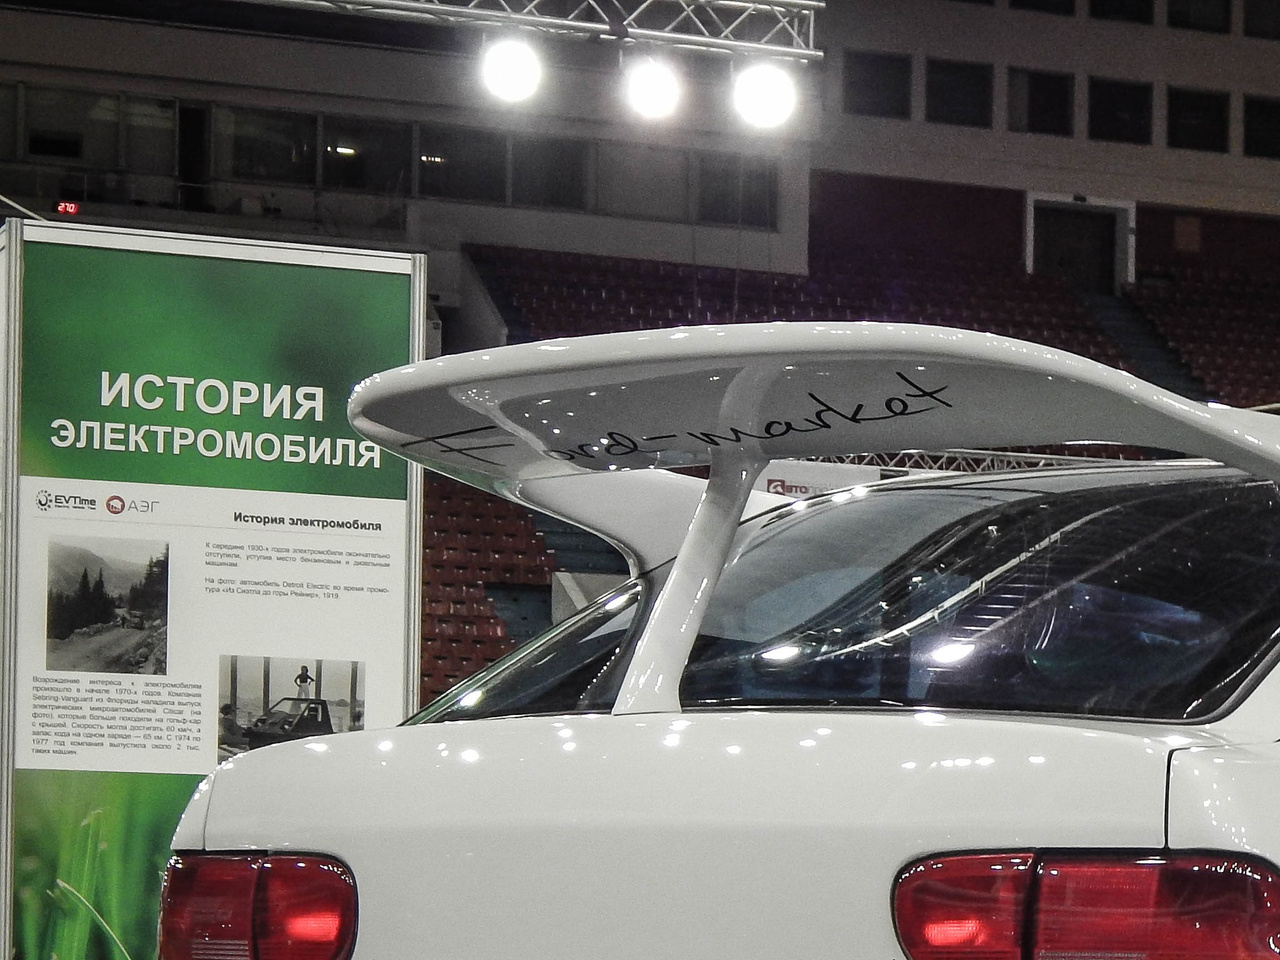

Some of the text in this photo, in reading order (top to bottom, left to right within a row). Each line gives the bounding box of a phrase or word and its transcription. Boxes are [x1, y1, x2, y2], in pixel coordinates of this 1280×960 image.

[99, 370, 325, 422] ИСТОРИЯ
[50, 418, 381, 469] ЭЛЕКТРОМОБИЛЯ
[127, 500, 160, 513] АЭГ
[234, 512, 382, 531] История электромобиля
